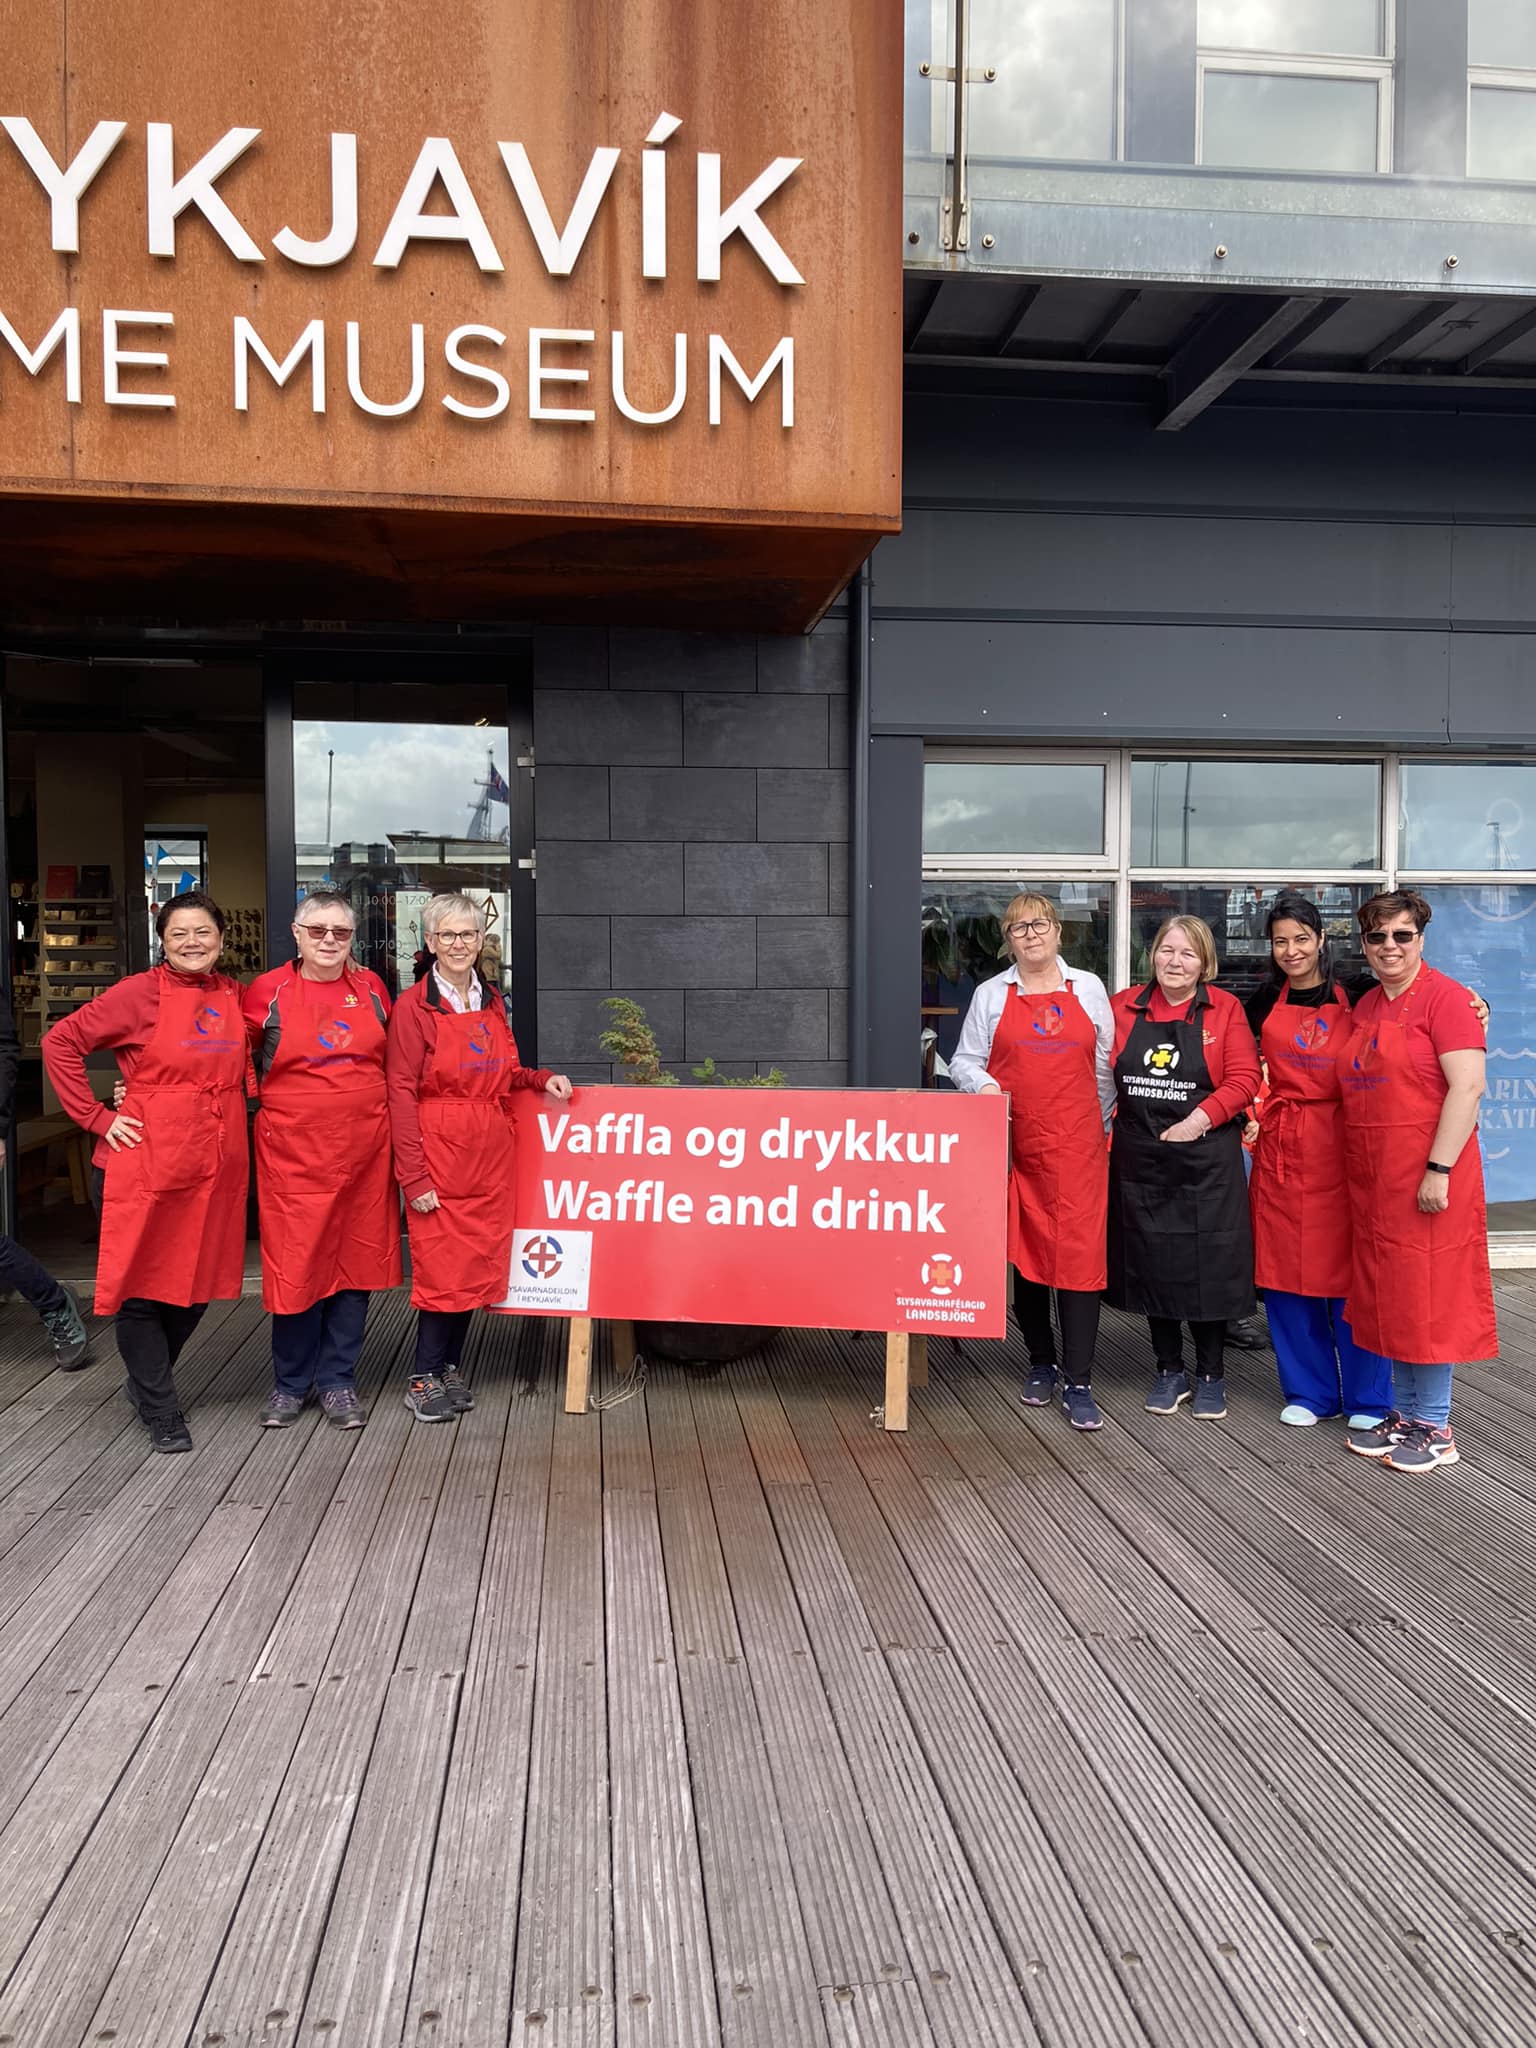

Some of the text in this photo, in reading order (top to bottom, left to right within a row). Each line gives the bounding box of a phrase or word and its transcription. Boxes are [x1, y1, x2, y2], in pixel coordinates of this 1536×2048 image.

[0, 110, 806, 286] YKJAVÍK
[0, 307, 796, 428] ME MUSEUM
[1128, 1086, 1188, 1101] LANDSBJÖRG
[537, 1113, 960, 1172] Vaffla og drykkur
[543, 1179, 948, 1234] Waffle and drink
[905, 1308, 976, 1323] LANDSBJÖRG
